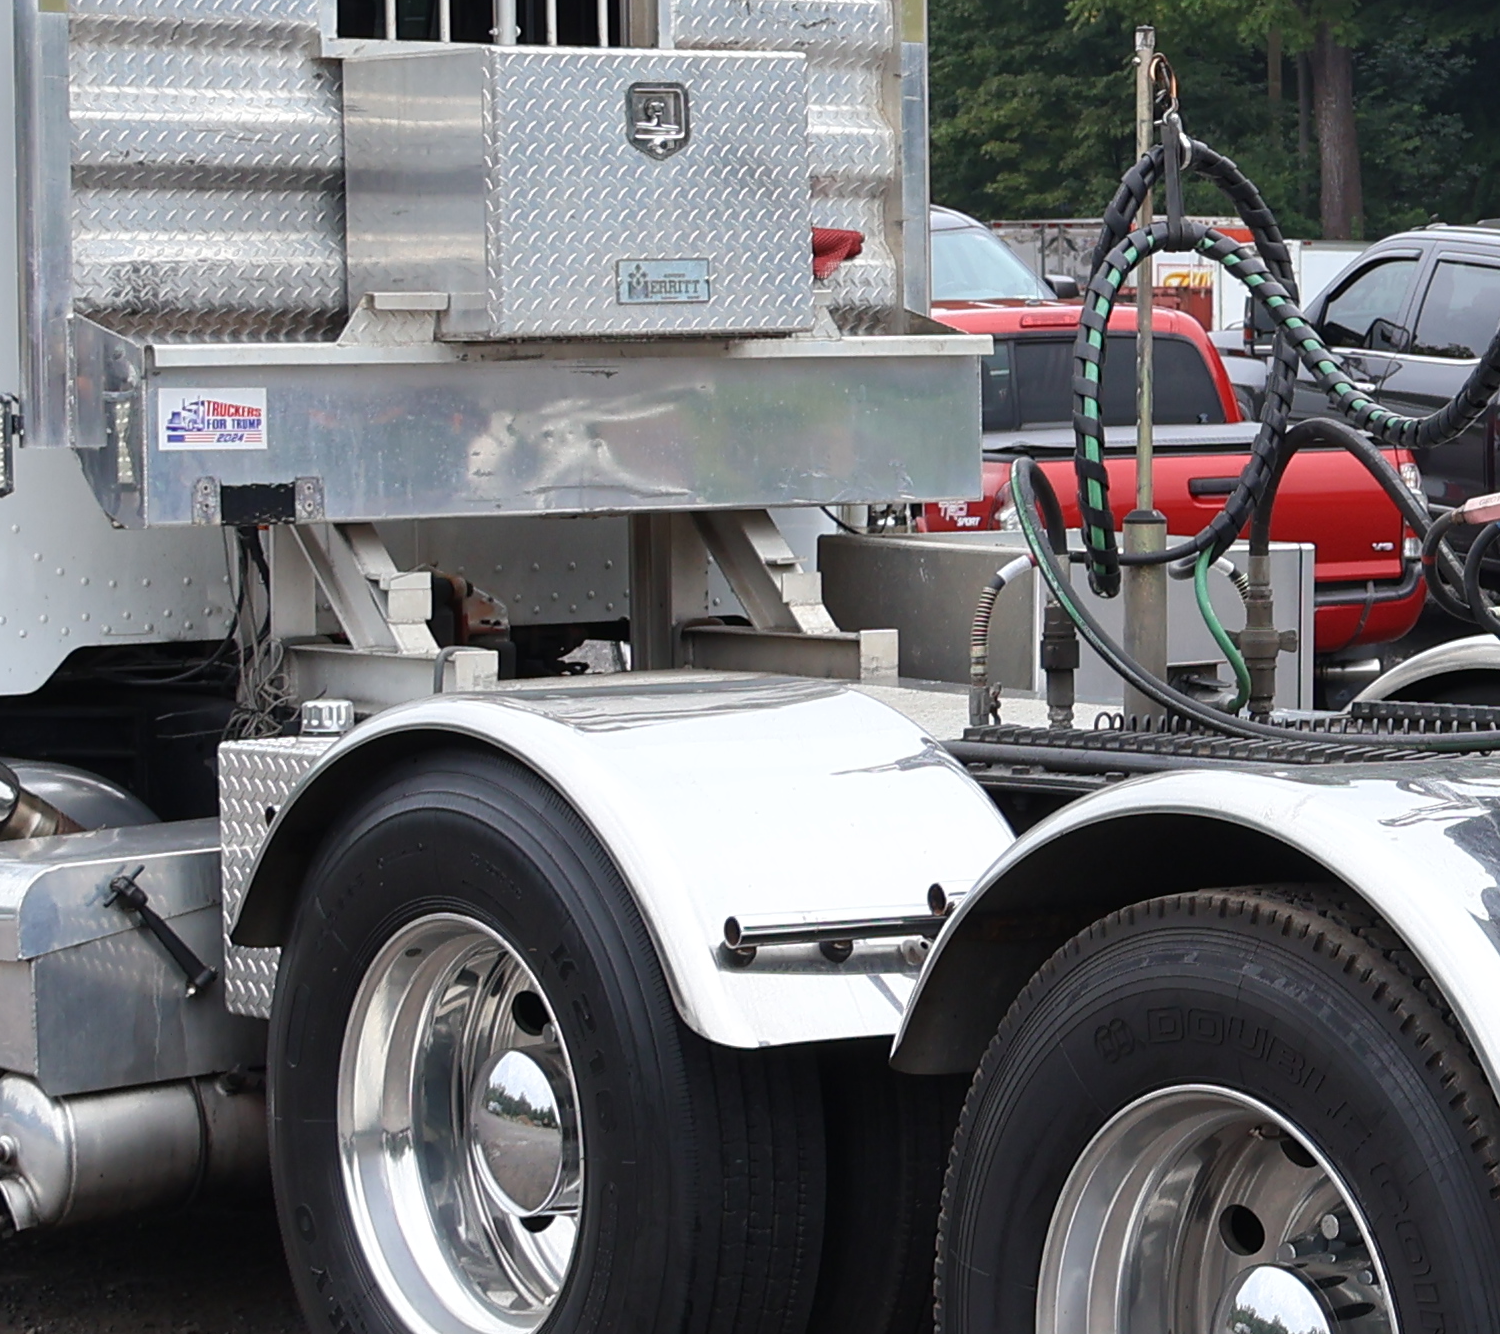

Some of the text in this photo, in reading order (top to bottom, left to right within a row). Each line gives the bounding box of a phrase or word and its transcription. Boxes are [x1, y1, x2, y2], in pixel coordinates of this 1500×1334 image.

[206, 400, 262, 418] TRUCKERS
[207, 419, 262, 430] FOR TRUMP
[216, 433, 245, 443] 2024
[956, 516, 981, 527] SPORT
